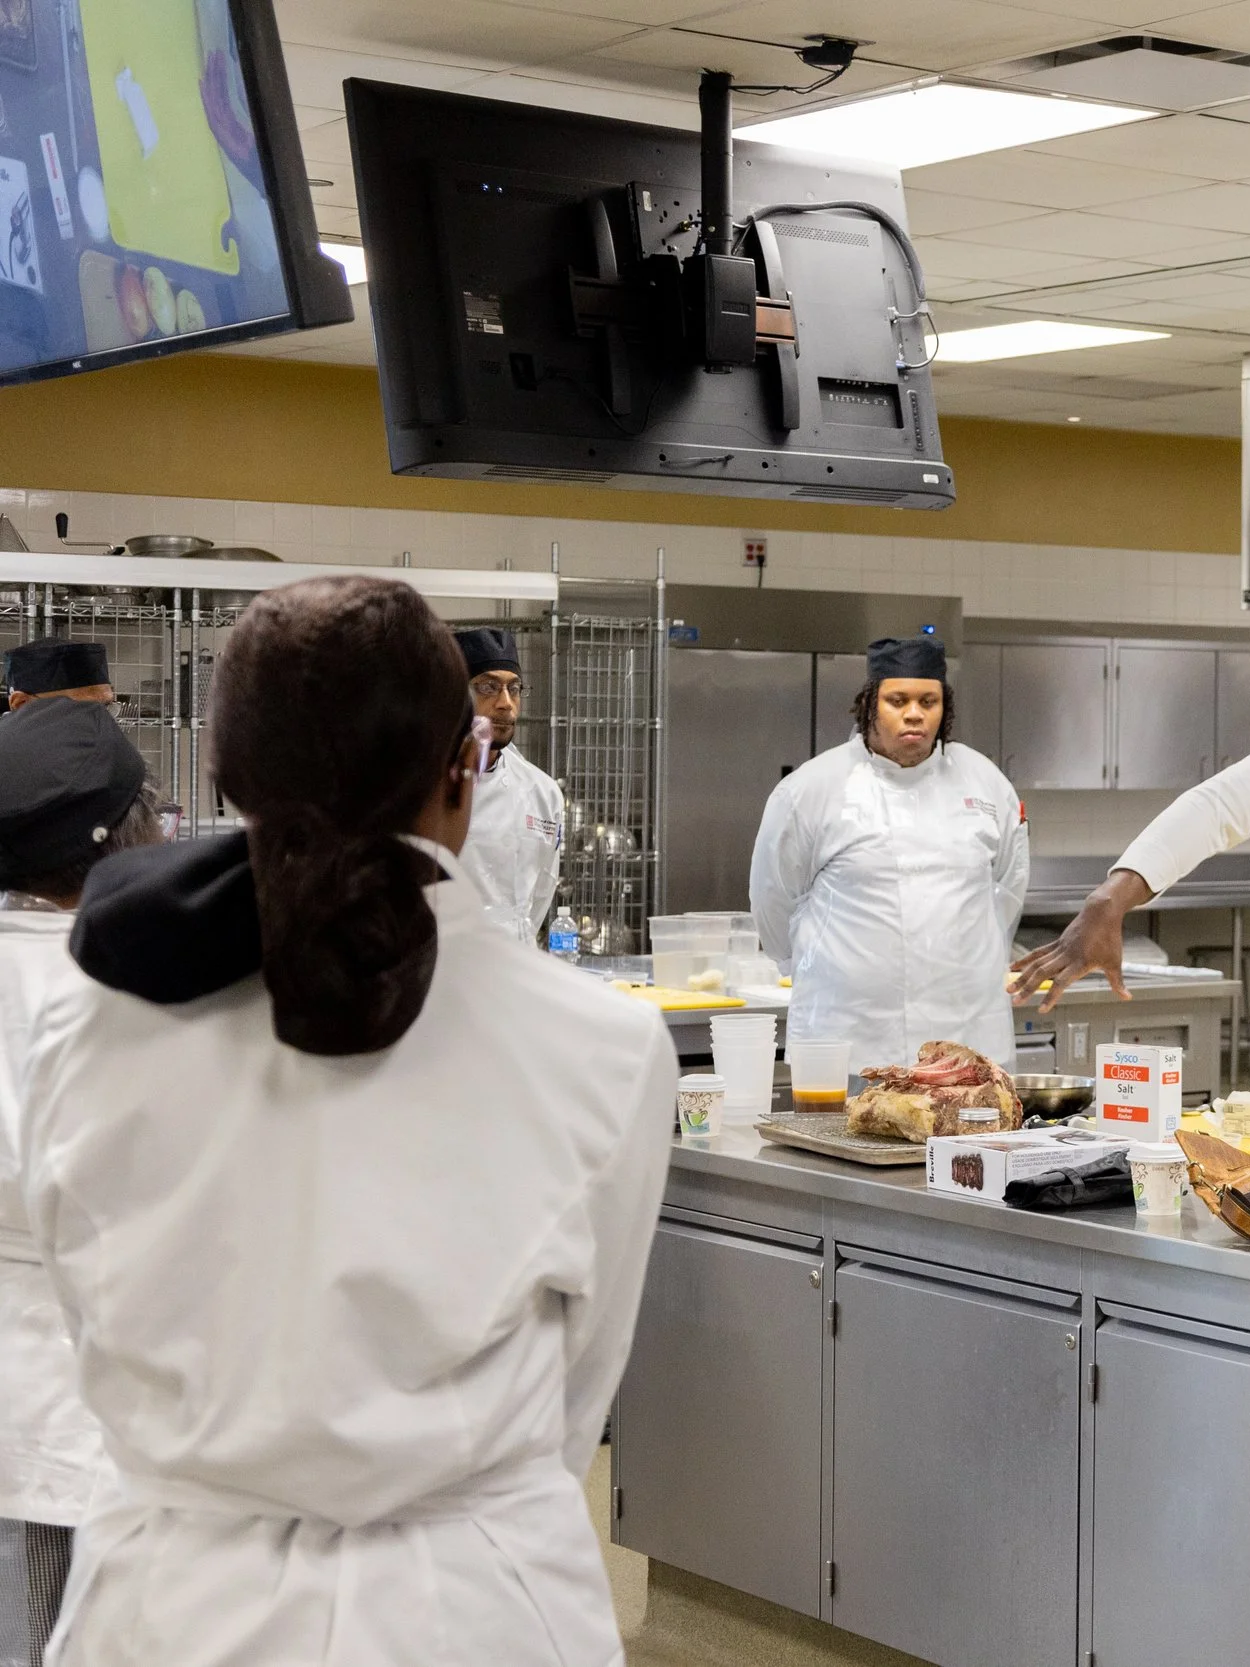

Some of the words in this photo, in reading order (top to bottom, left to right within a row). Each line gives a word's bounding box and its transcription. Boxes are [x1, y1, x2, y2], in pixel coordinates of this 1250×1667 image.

[1115, 1051, 1138, 1064] Sysco
[1164, 1054, 1177, 1063] Salt
[1110, 1065, 1142, 1081] Classic
[1117, 1083, 1134, 1094] Salt
